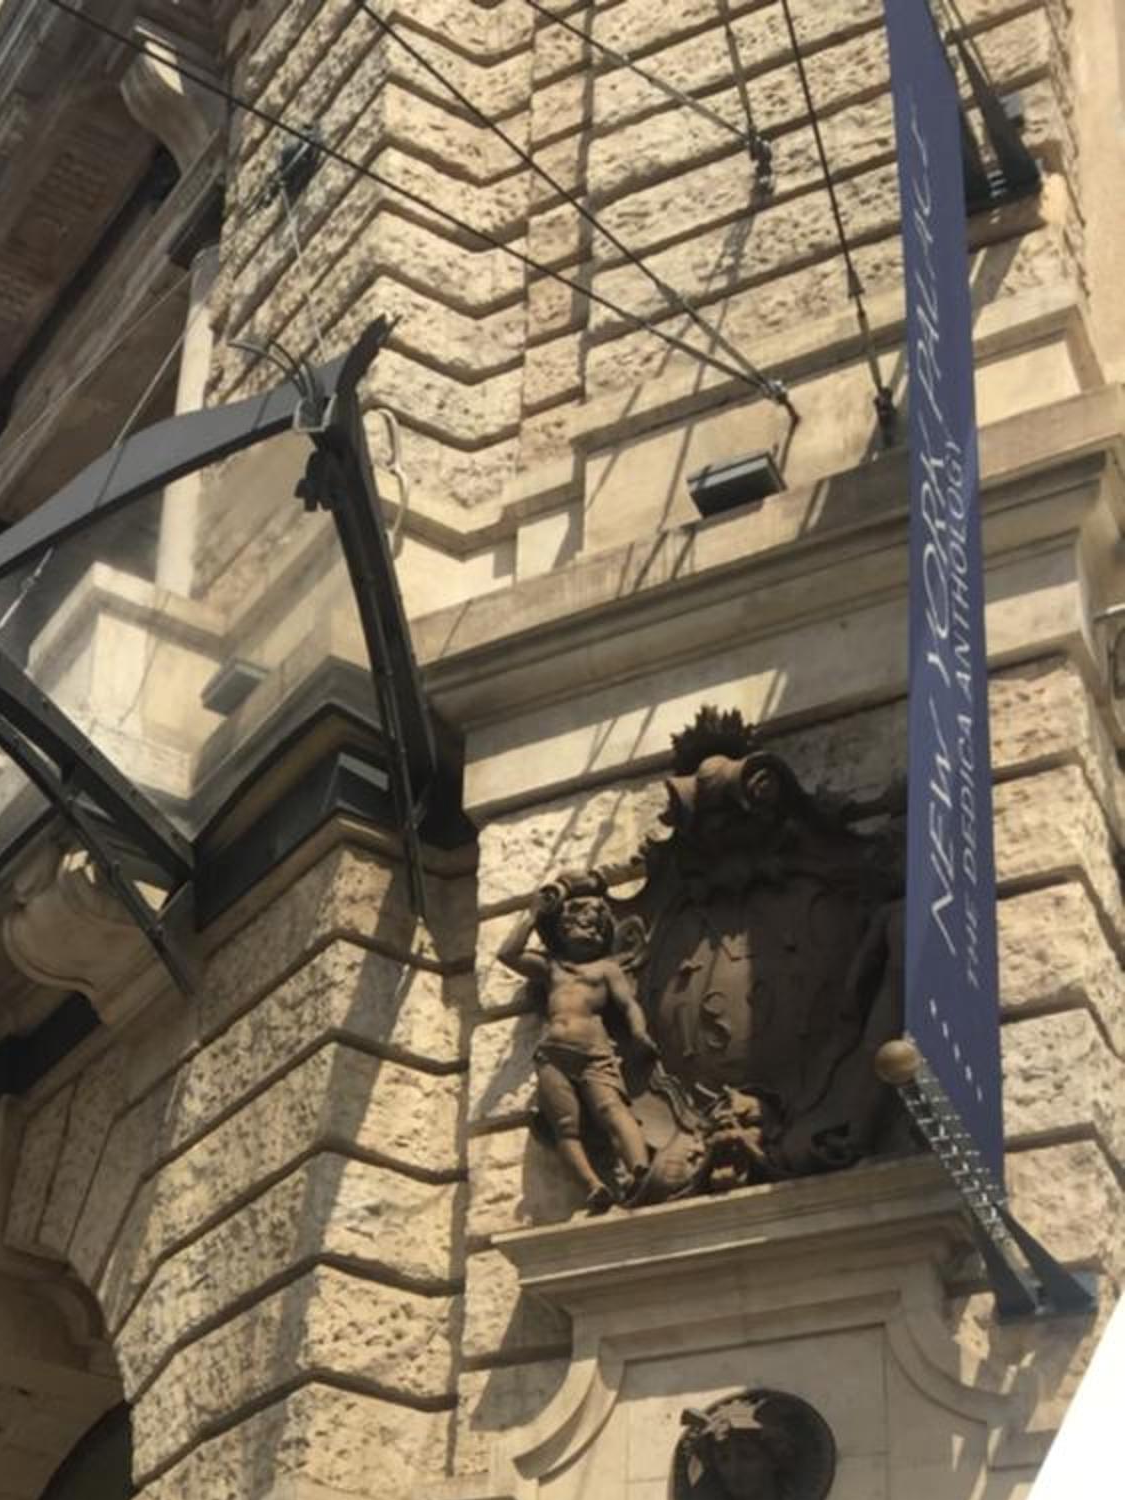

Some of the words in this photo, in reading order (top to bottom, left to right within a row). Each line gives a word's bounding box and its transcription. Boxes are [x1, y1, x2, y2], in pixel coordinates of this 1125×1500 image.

[920, 408, 951, 688] YORK
[944, 439, 973, 702] ANTHOLOGY
[929, 696, 956, 956] NEW
[957, 712, 977, 886] DEDICA
[964, 890, 979, 990] THE
